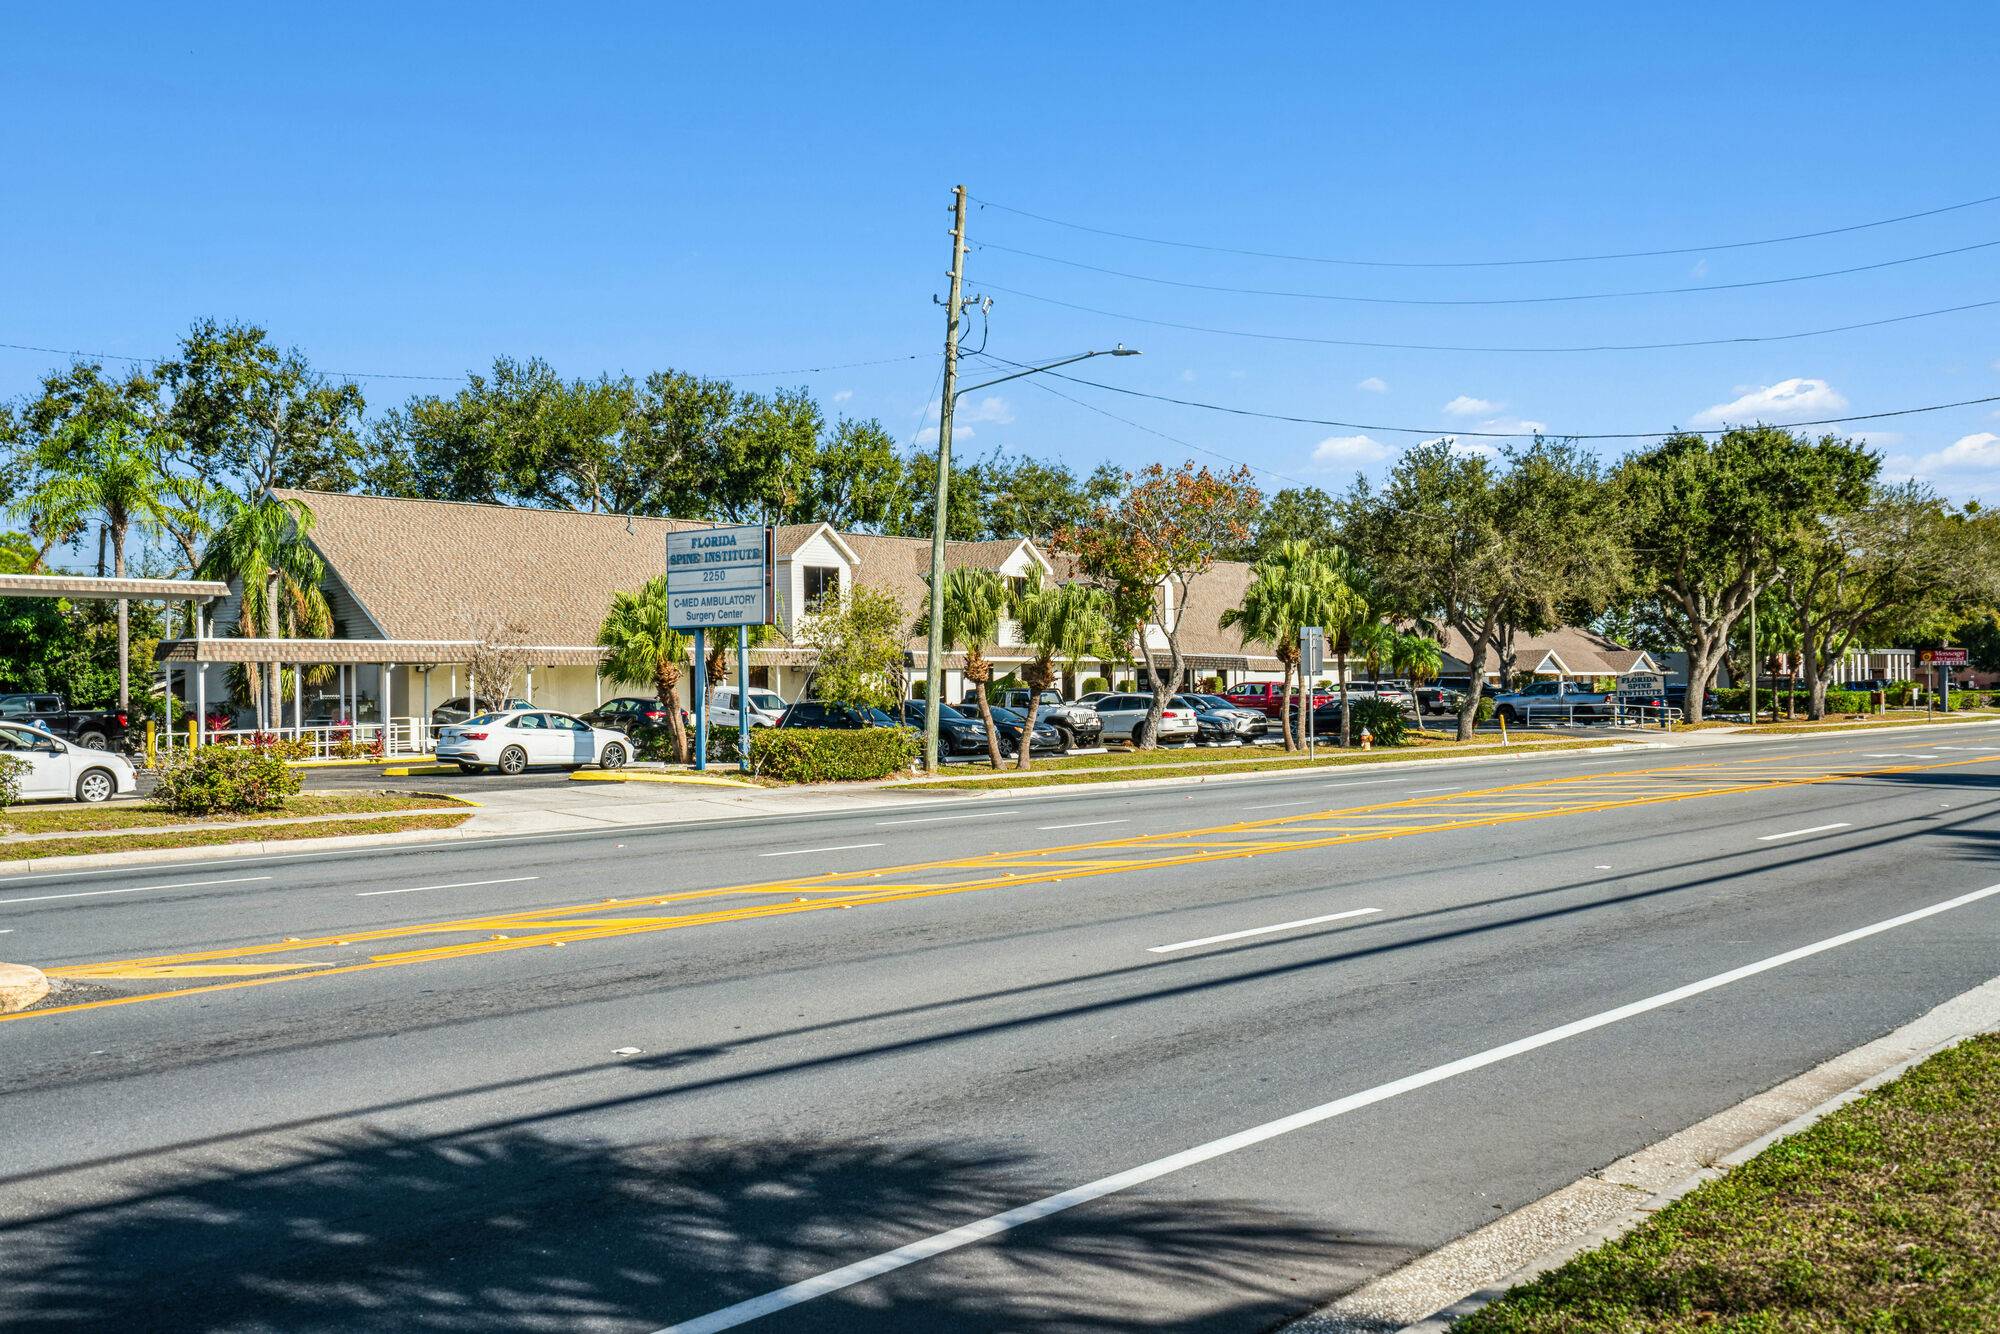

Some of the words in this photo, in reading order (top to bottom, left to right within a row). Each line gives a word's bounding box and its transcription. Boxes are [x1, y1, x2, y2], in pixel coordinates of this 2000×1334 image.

[691, 535, 737, 549] FLORIDA
[670, 553, 700, 565] SPINE
[704, 549, 760, 563] INSTITUTE
[703, 571, 726, 582] 2250
[674, 598, 699, 608] C-MED
[701, 595, 756, 606] AMBULATORY
[686, 610, 715, 622] Surgery
[718, 609, 743, 619] Center
